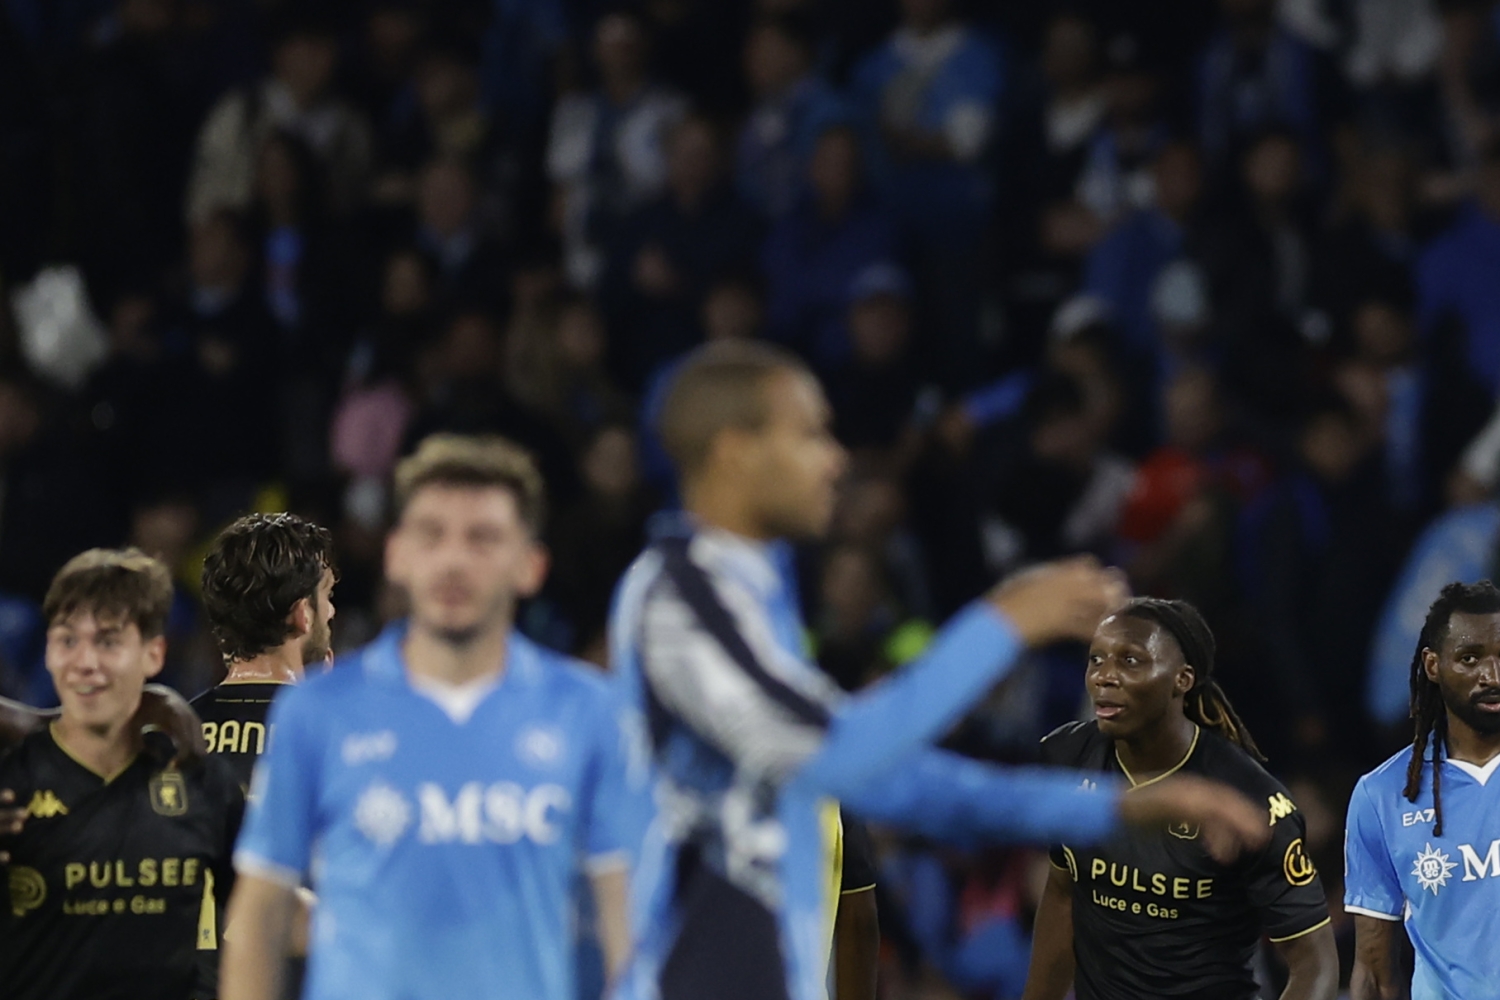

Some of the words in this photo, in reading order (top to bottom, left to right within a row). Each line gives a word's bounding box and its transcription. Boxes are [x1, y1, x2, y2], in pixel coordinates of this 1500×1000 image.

[418, 781, 573, 845] MSC
[1402, 808, 1436, 827] EA7
[65, 858, 199, 889] PULSEE
[1091, 858, 1213, 898] PULSEE
[1093, 890, 1126, 912] Luce
[1131, 902, 1141, 914] e
[1147, 903, 1179, 919] Gas
